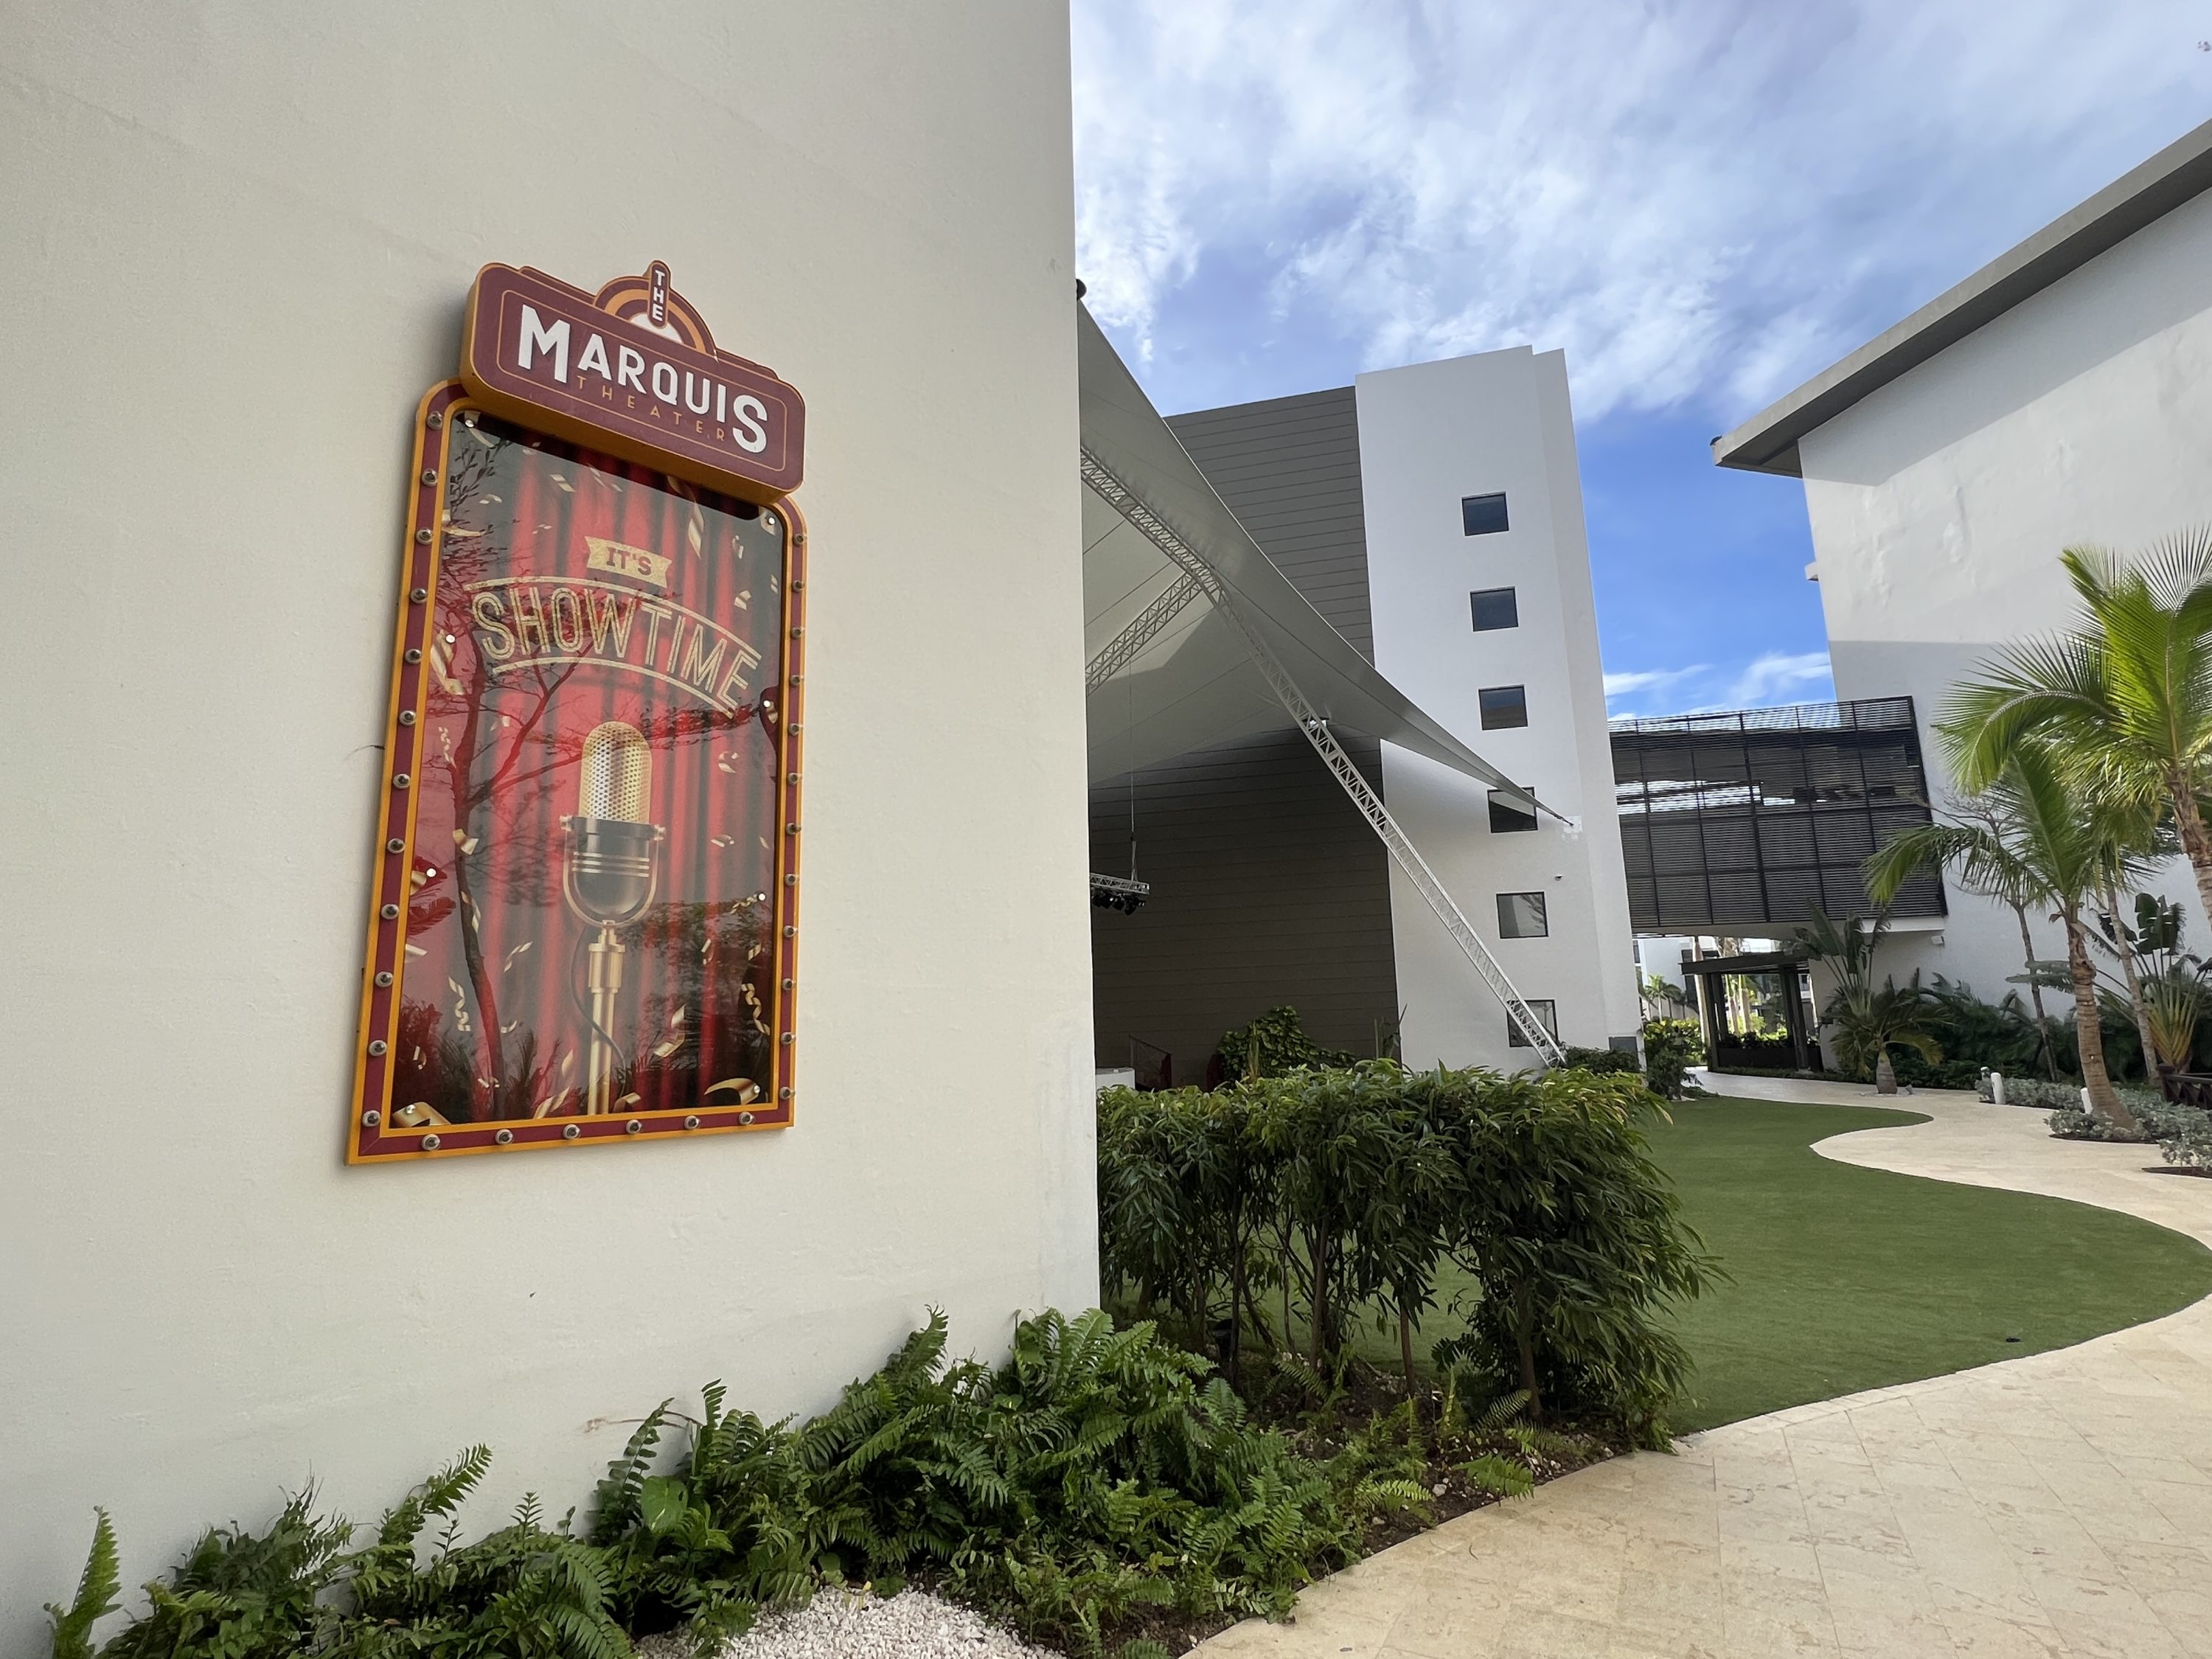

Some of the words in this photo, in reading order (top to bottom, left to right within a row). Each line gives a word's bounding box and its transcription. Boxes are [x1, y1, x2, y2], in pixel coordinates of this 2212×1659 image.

[653, 268, 666, 322] THE
[517, 303, 768, 453] MARQUIS
[577, 375, 726, 442] THEATER
[605, 546, 652, 576] IT'S
[471, 586, 759, 710] SHOWTIME
